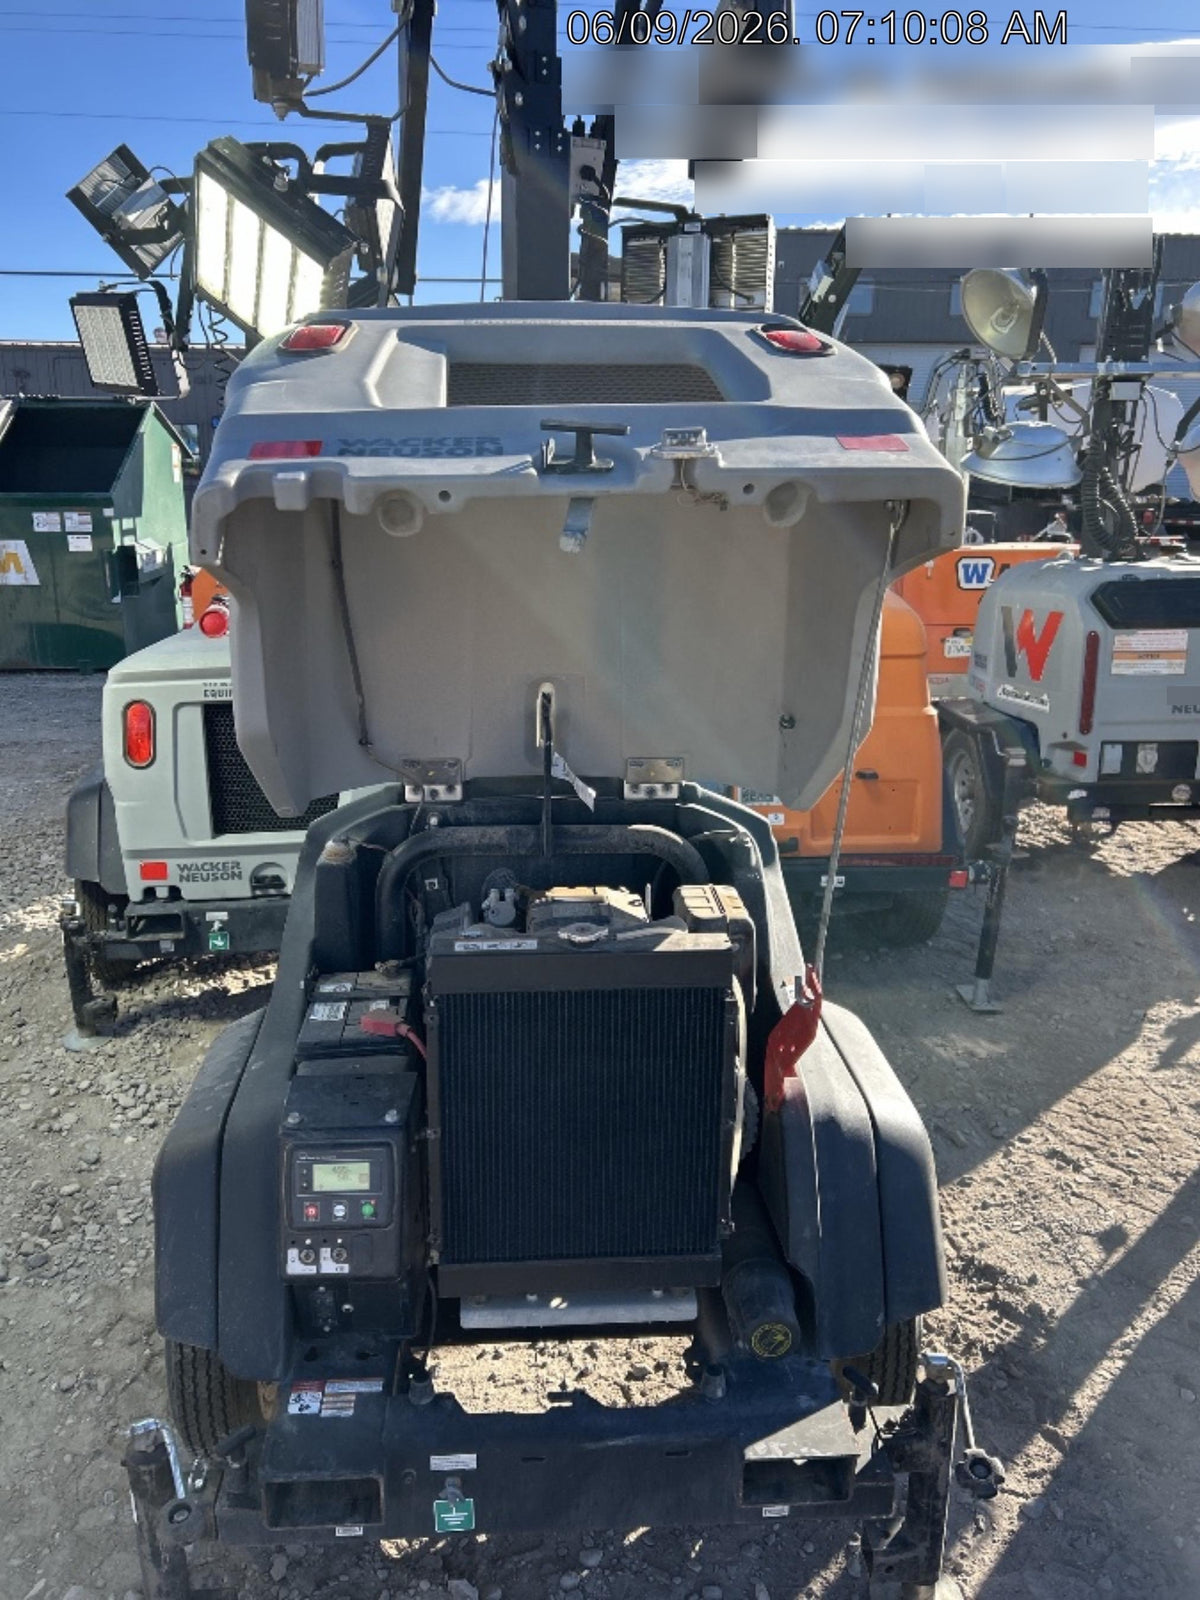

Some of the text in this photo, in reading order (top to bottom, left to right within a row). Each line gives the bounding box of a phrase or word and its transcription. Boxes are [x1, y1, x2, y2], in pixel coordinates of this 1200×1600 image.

[337, 437, 502, 448] WACKER
[176, 861, 242, 873] WACKER
[178, 871, 243, 883] NEUSON
